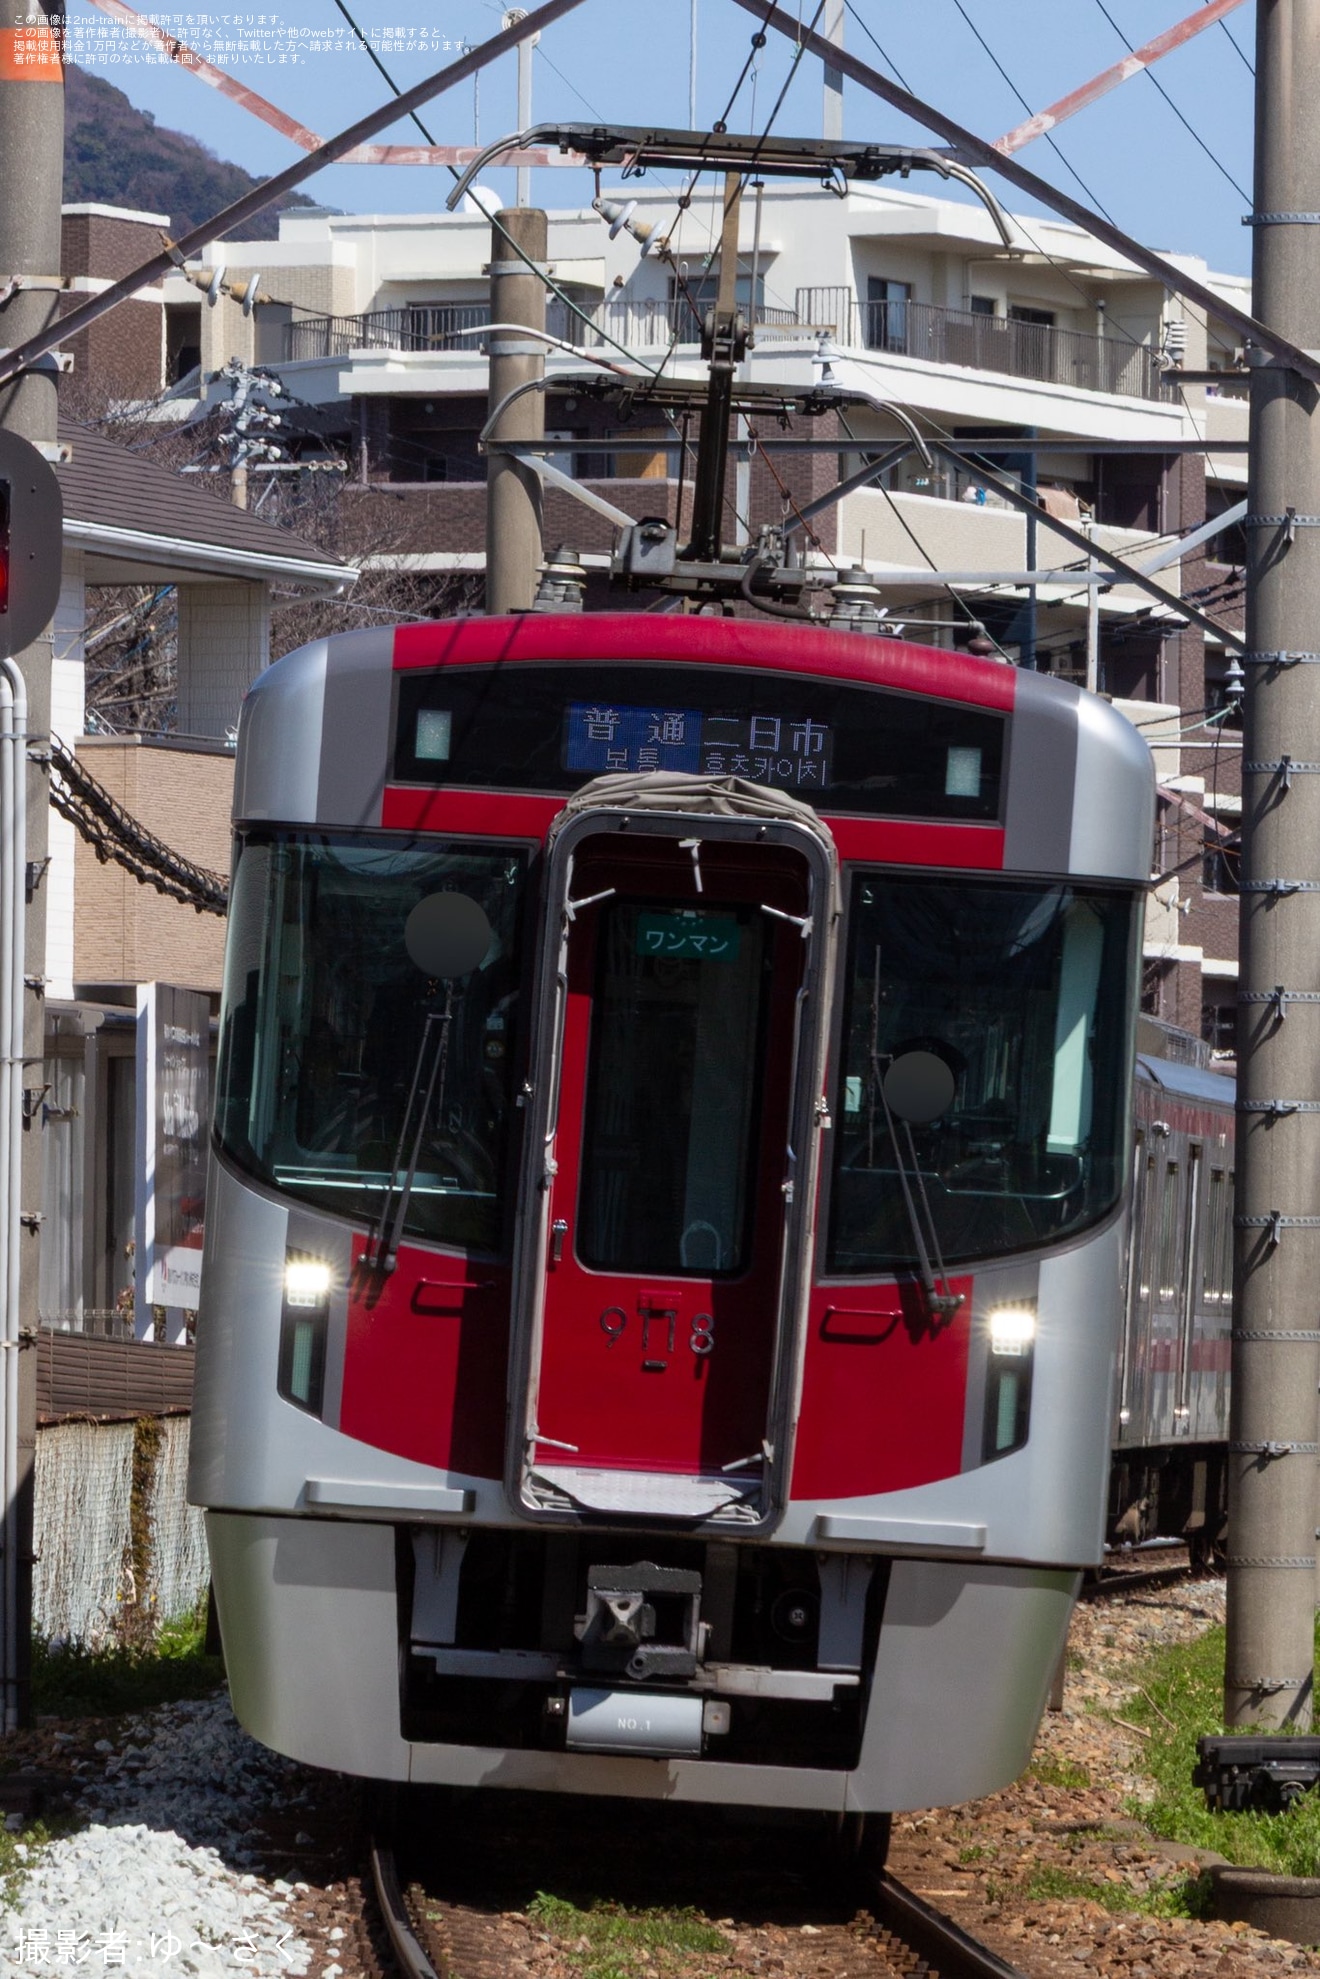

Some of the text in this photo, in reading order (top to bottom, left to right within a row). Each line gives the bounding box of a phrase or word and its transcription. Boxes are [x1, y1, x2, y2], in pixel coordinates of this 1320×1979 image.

[703, 716, 829, 757] 二日市
[646, 931, 729, 953] ワンマン
